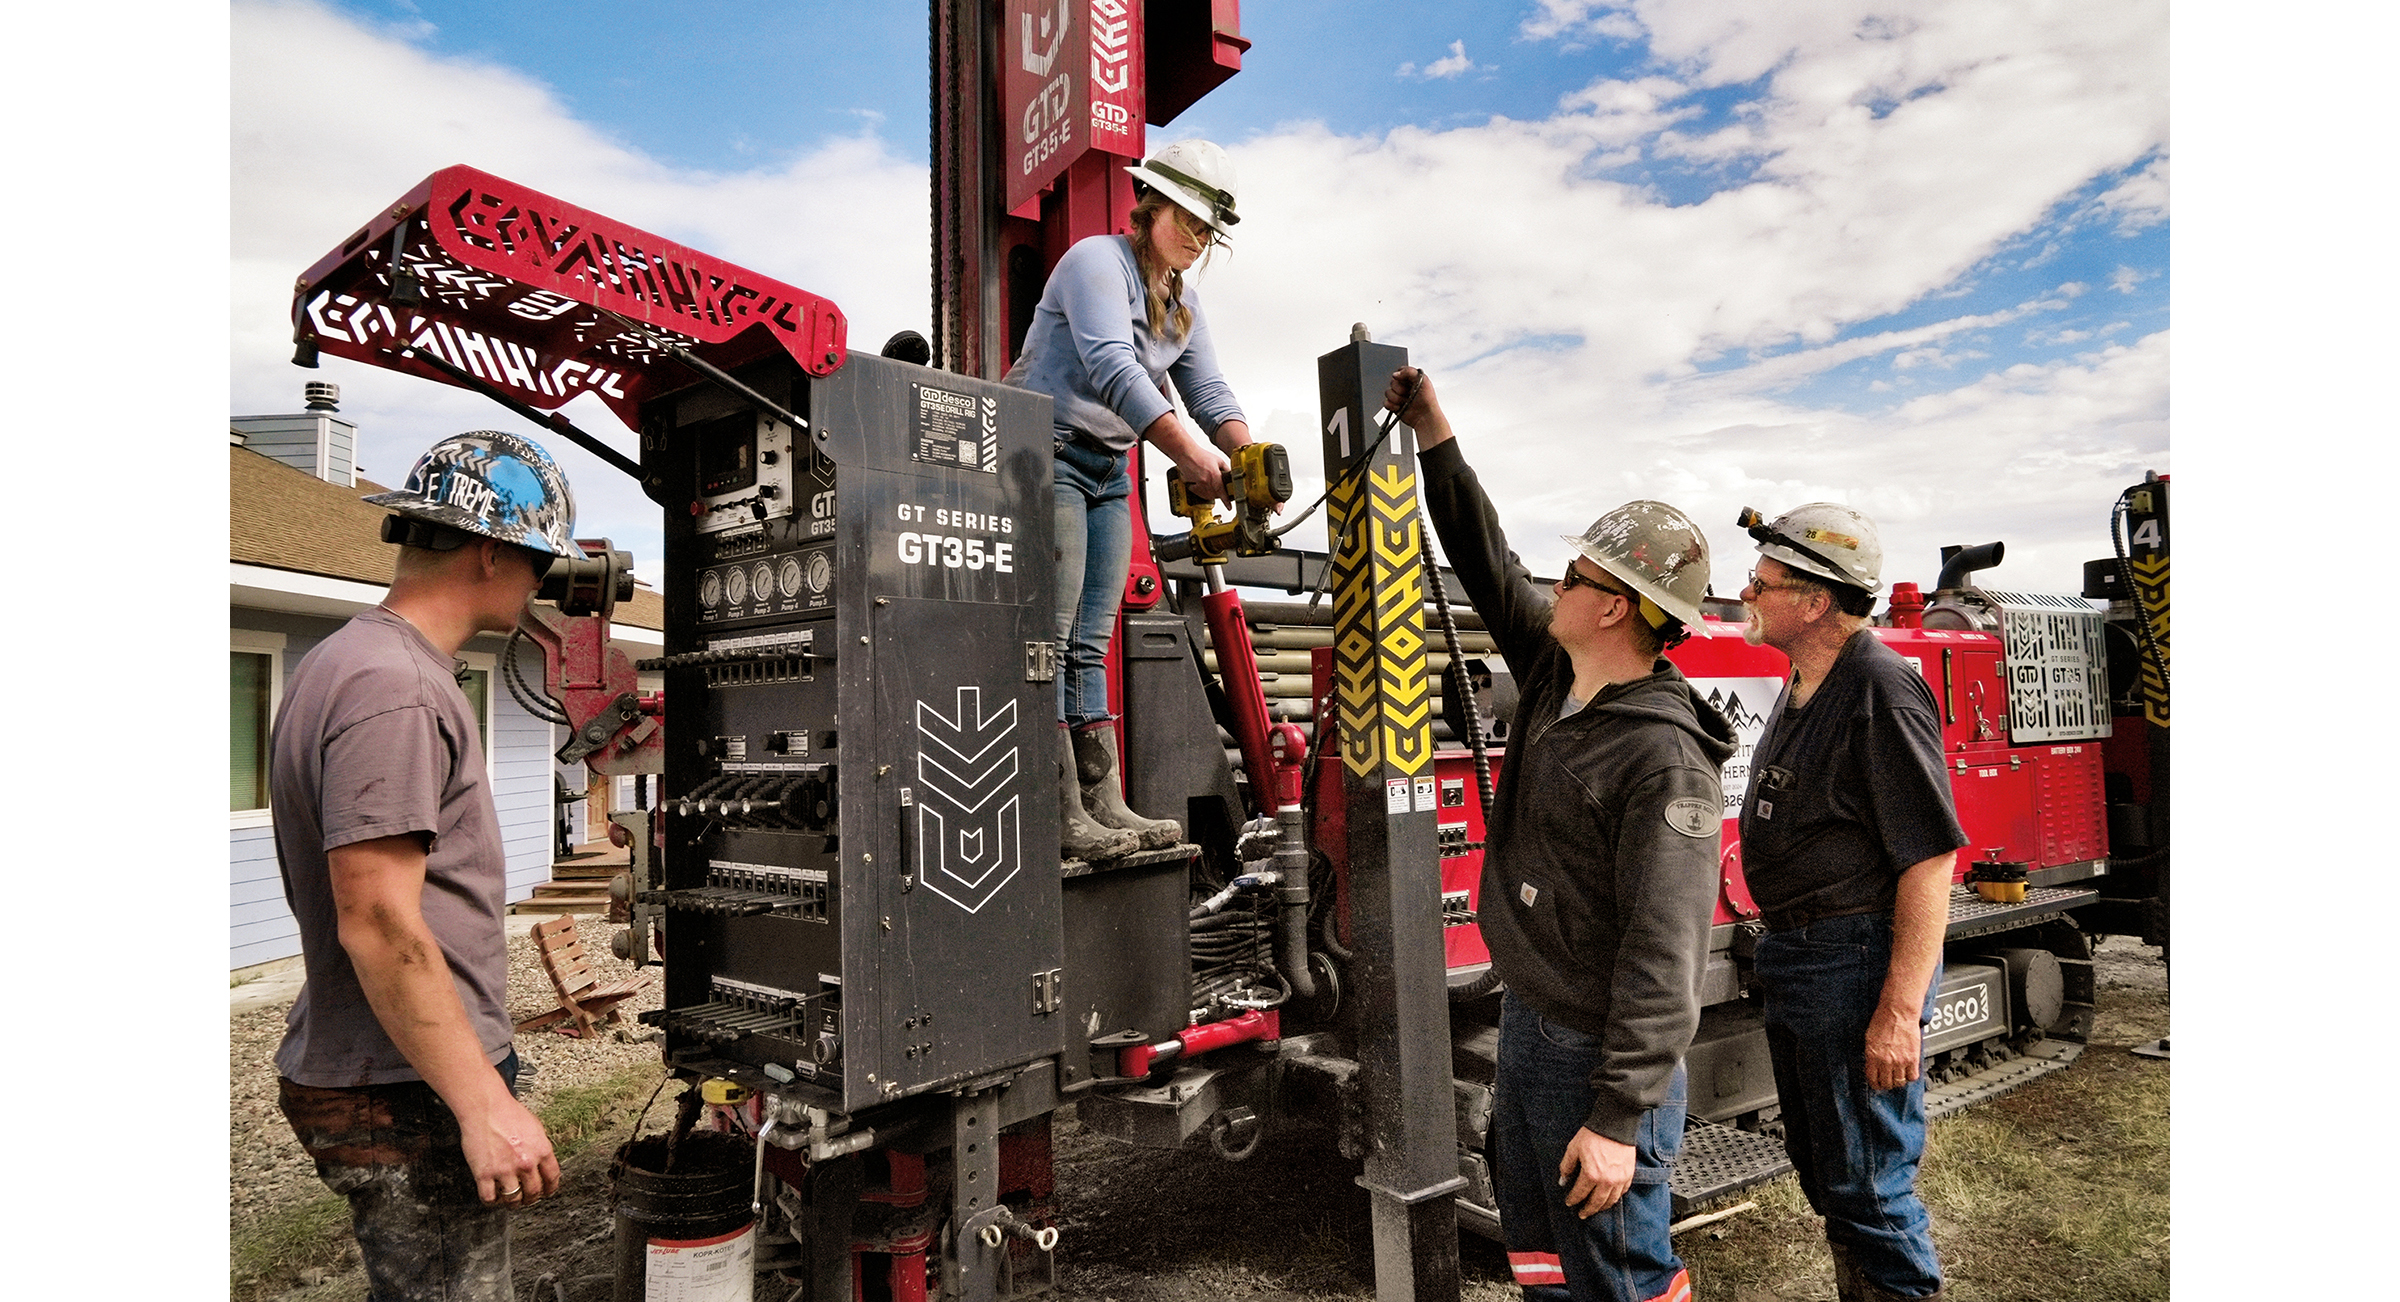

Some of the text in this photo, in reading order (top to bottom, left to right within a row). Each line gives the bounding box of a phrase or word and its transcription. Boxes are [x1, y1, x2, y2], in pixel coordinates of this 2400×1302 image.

[1023, 72, 1071, 145] GTD
[1091, 100, 1129, 124] GTD
[1091, 117, 1129, 136] GT35-E
[1023, 117, 1071, 176] GT35-E
[941, 391, 971, 407] desco
[945, 405, 964, 416] DRILL
[964, 408, 976, 418] RIG
[1326, 406, 1351, 459] 1
[1372, 406, 1402, 455] 1
[423, 467, 500, 523] EXTREME
[811, 490, 836, 519] GT
[897, 503, 1013, 534] GT SERIES
[2132, 518, 2162, 549] 4
[897, 531, 1014, 574] GT35-E
[2060, 655, 2081, 663] SERIES
[2052, 667, 2082, 683] GT35
[1923, 996, 1979, 1034] esco
